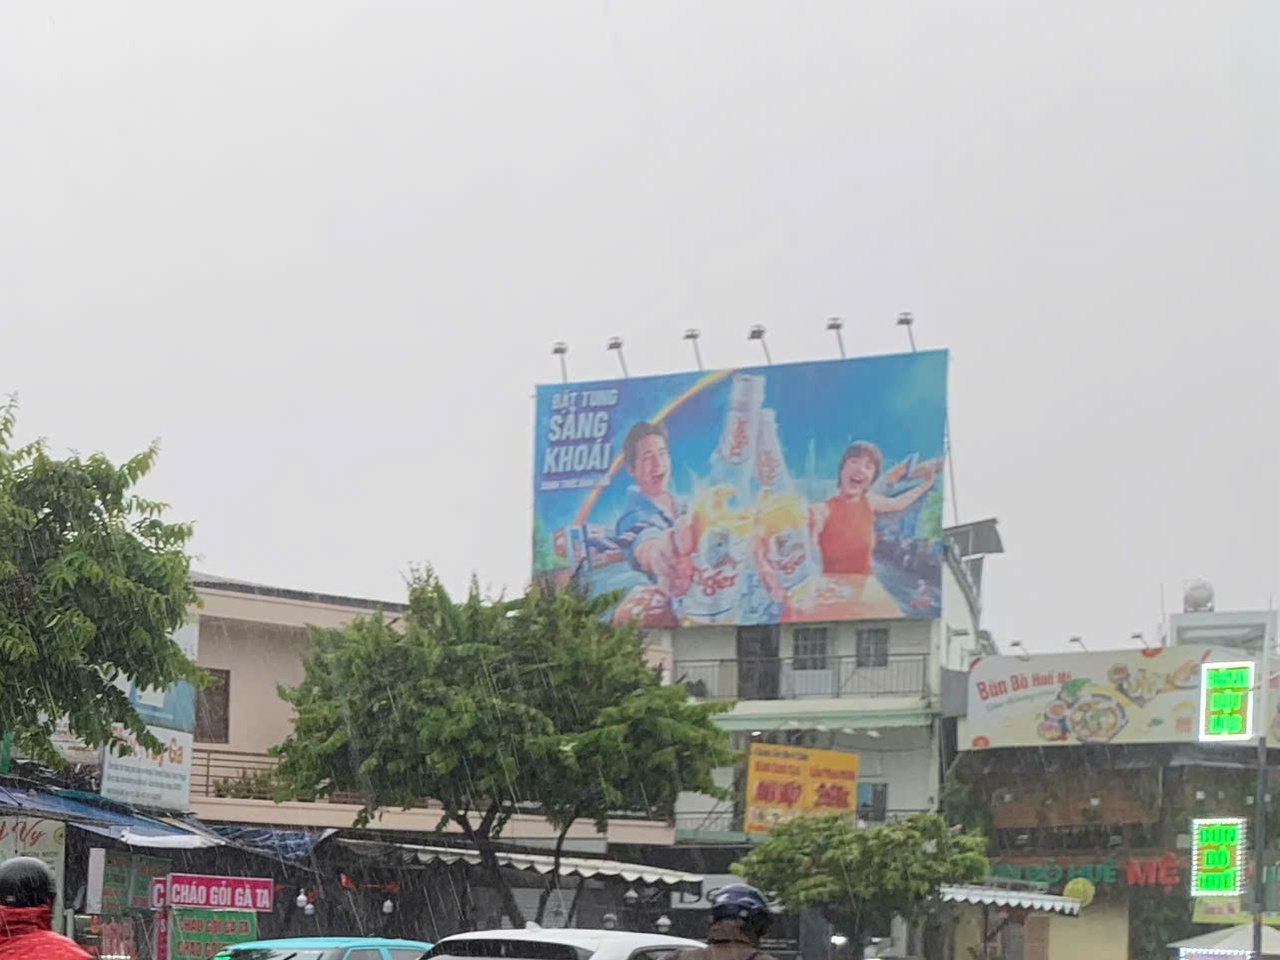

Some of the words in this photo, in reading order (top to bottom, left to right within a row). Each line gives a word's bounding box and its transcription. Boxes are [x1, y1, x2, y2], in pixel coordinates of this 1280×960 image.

[543, 438, 612, 474] KHOÁI
[1125, 852, 1180, 896] MẸ
[172, 880, 207, 905] CHÁO
[209, 880, 232, 902] GỎI
[234, 881, 253, 907] GÀ
[256, 888, 271, 909] TA
